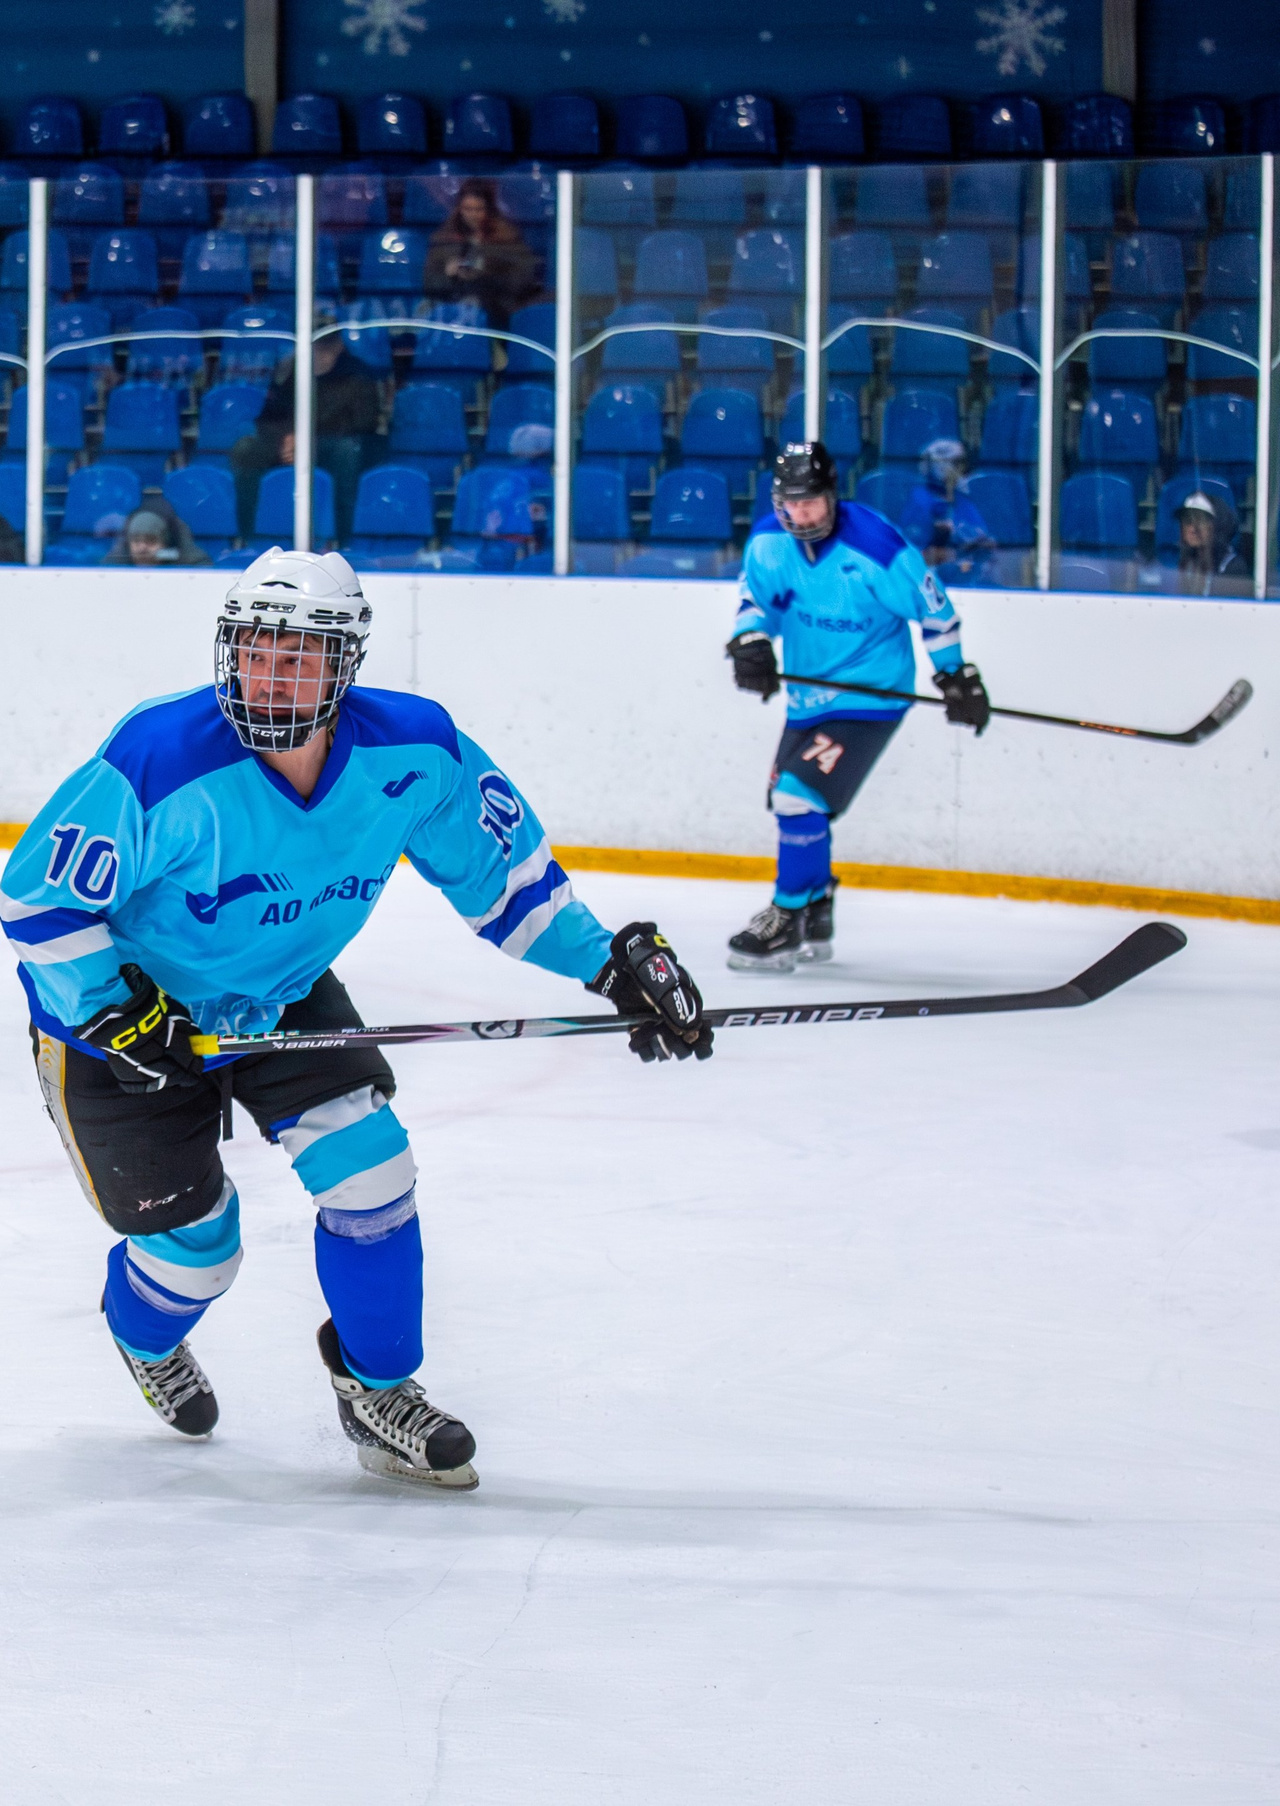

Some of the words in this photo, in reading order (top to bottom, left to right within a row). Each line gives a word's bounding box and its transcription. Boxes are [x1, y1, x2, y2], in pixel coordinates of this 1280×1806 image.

[251, 727, 286, 738] CCM
[801, 731, 844, 775] 74
[477, 770, 524, 862] 10
[44, 822, 120, 906] 10
[723, 1006, 885, 1028] BAUER
[285, 1039, 346, 1049] BAUER
